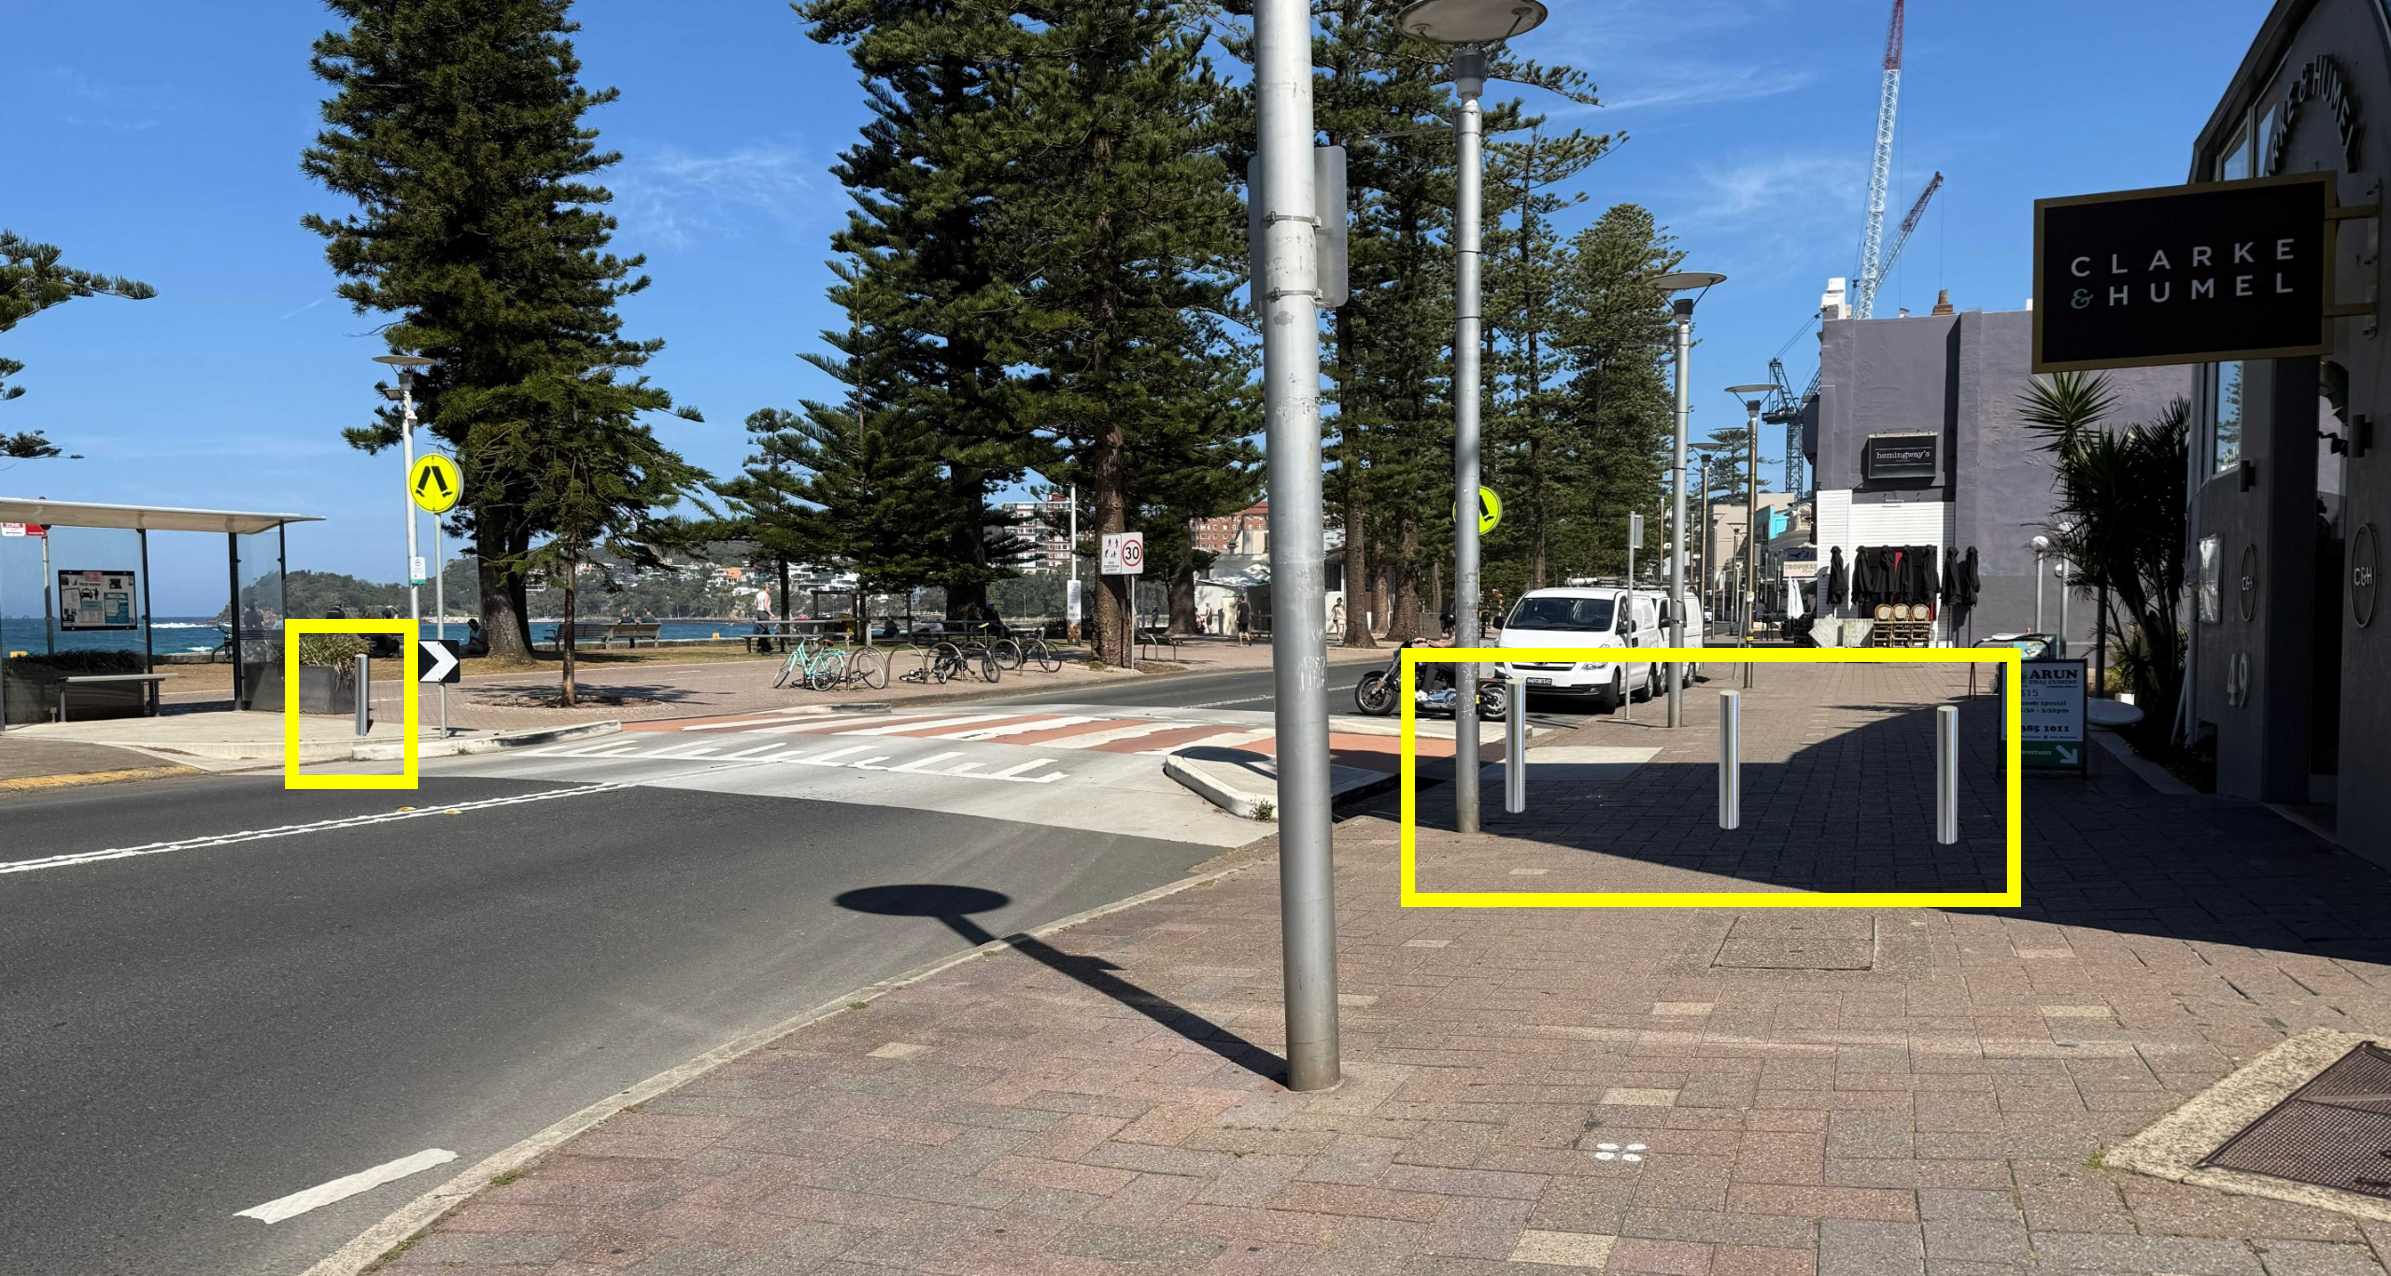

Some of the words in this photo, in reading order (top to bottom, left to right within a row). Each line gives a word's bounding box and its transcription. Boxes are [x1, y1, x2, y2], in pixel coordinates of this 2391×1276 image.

[2070, 238, 2296, 278] CLARKE
[1876, 450, 1931, 460] hemingway's
[1125, 546, 1140, 560] 30
[2354, 566, 2373, 586] C&H
[2029, 669, 2078, 679] ARUN
[2227, 653, 2249, 708] 49
